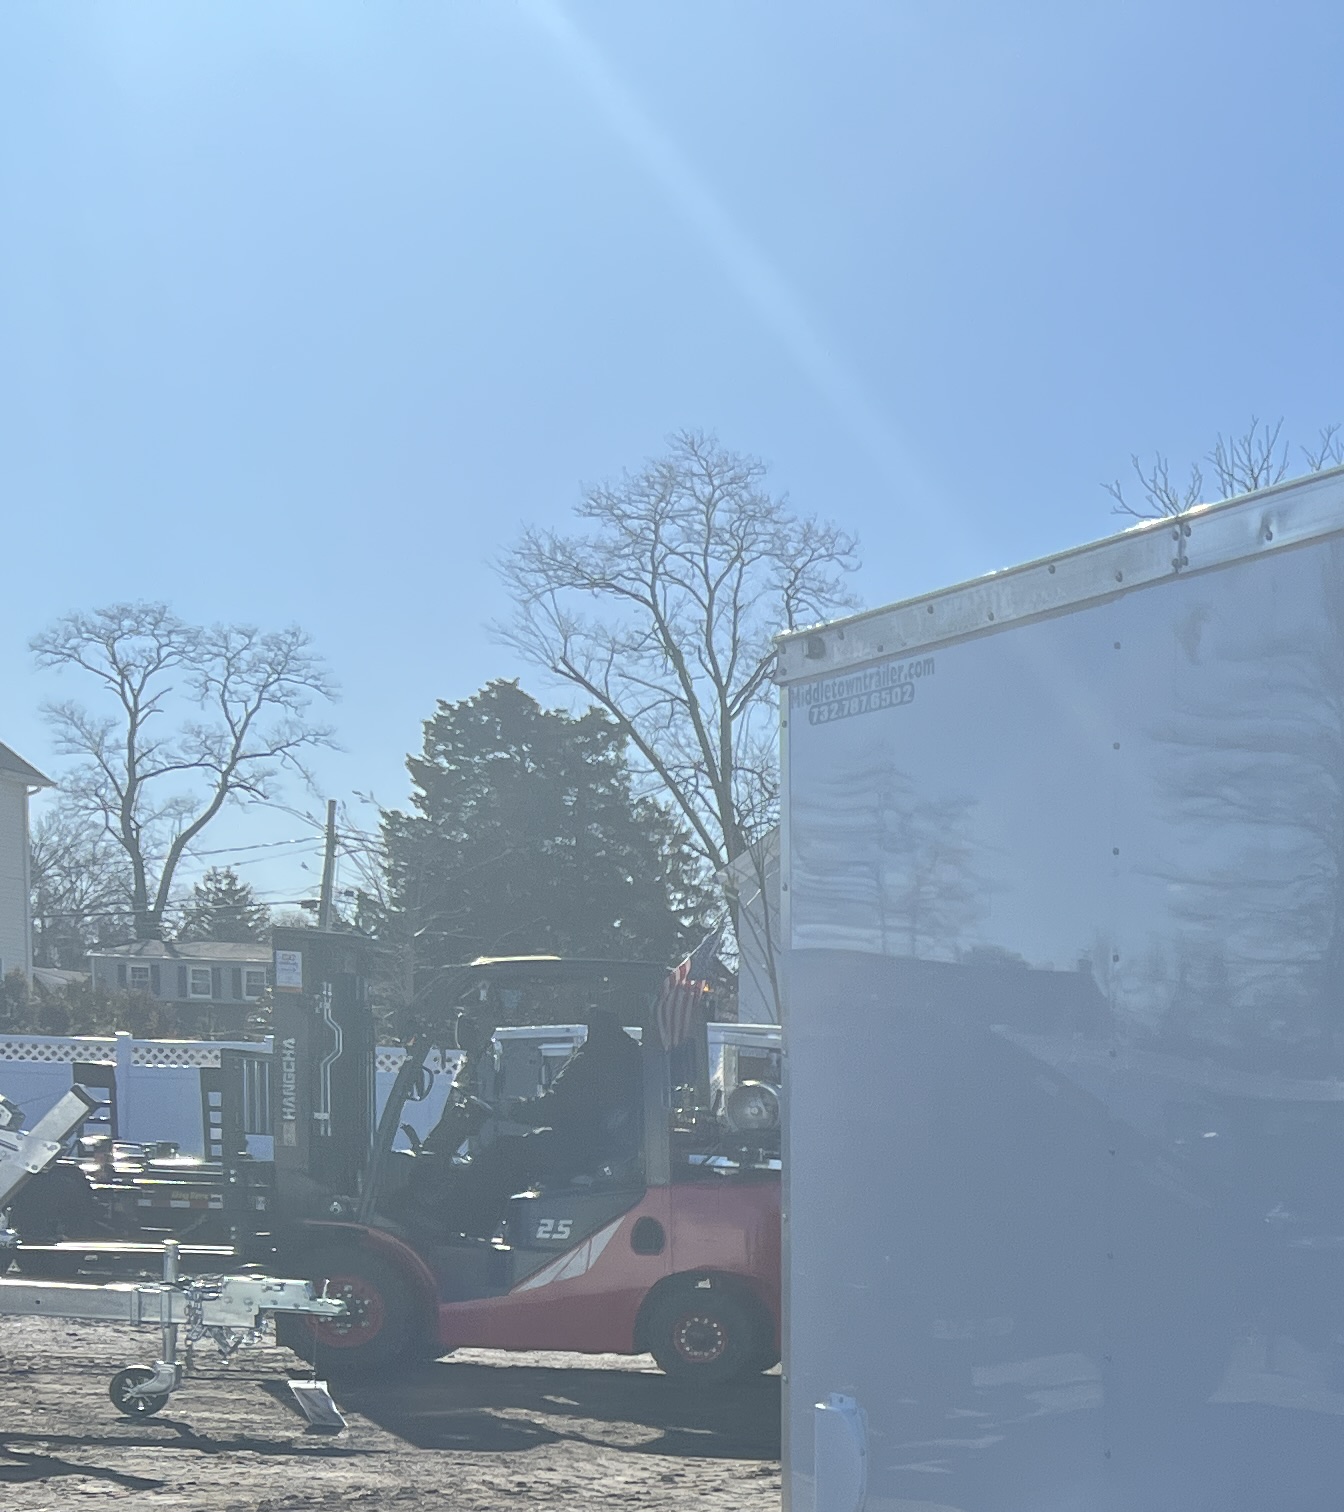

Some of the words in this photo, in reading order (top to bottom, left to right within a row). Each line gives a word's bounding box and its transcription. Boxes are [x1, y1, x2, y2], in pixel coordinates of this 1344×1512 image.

[790, 656, 936, 709] Middletowntrailer.com
[810, 684, 914, 723] 732.787.6502
[282, 1037, 296, 1120] HANGCHA
[536, 1218, 574, 1240] 25
